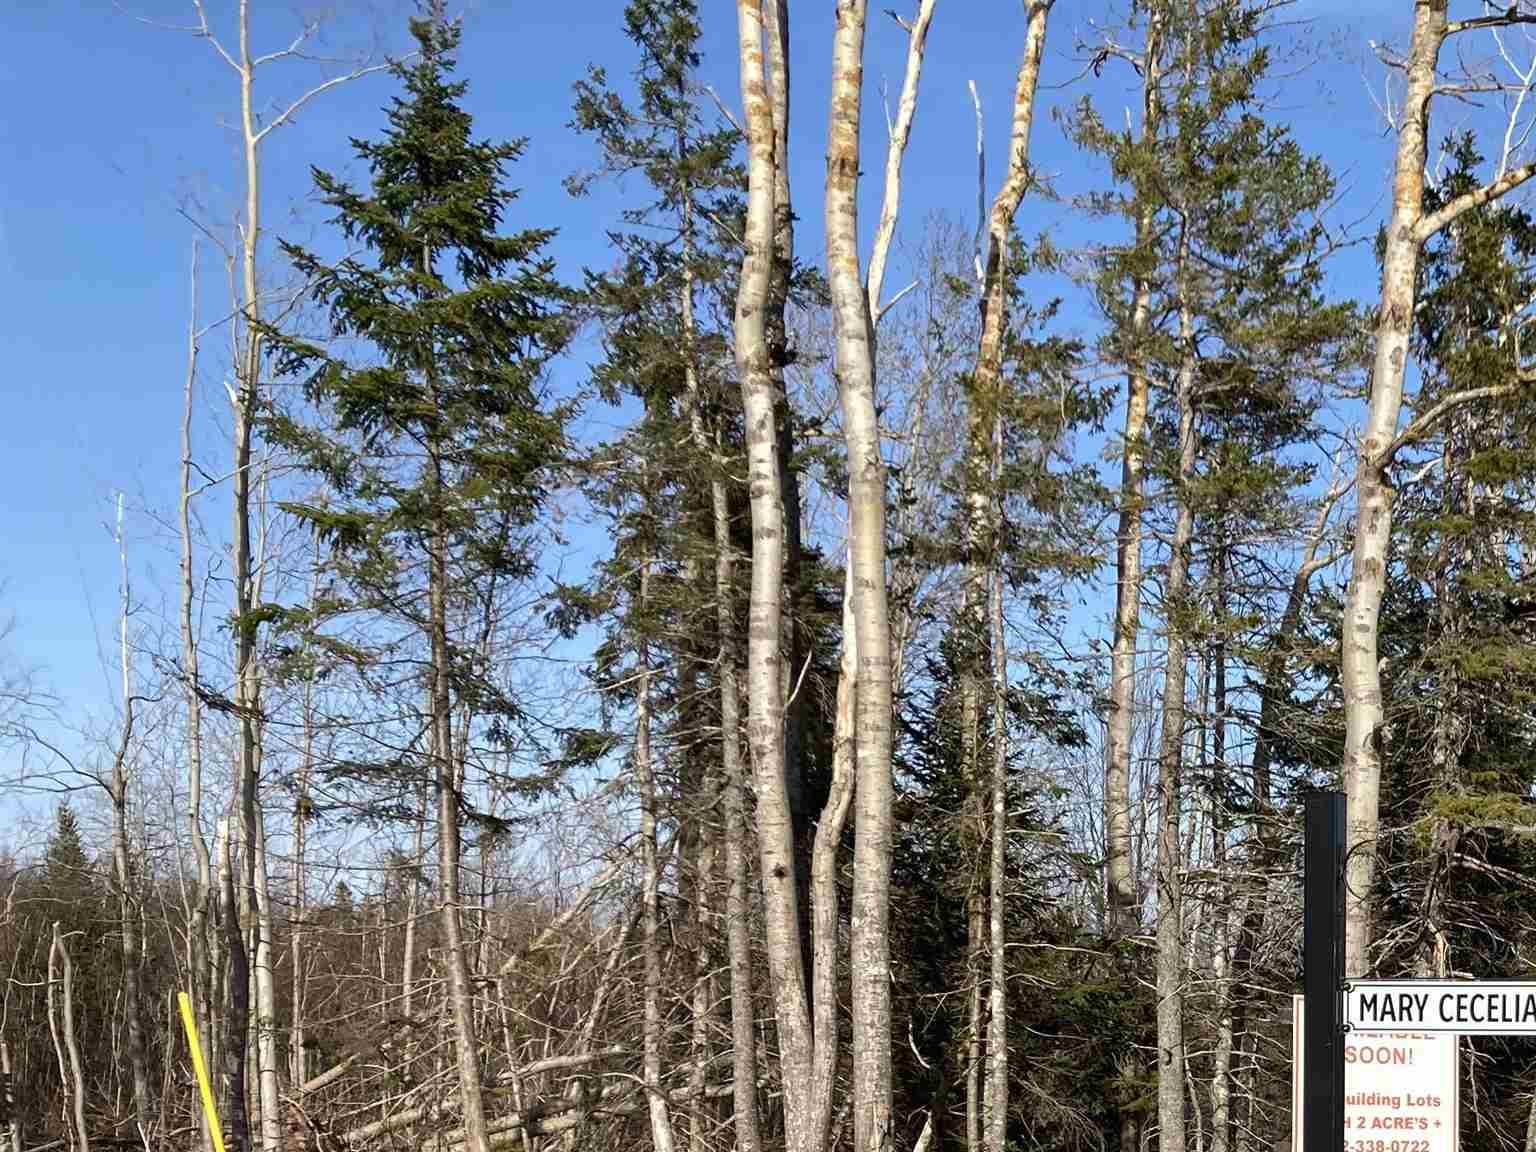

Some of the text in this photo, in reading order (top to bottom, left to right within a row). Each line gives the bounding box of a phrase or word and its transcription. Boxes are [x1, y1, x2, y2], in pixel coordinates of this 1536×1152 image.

[1359, 993, 1429, 1022] MARY
[1345, 1046, 1413, 1065] SOON!
[1345, 1092, 1441, 1109] uilding Lots
[1357, 1116, 1366, 1129] 2
[1371, 1116, 1429, 1130] ACRE'S
